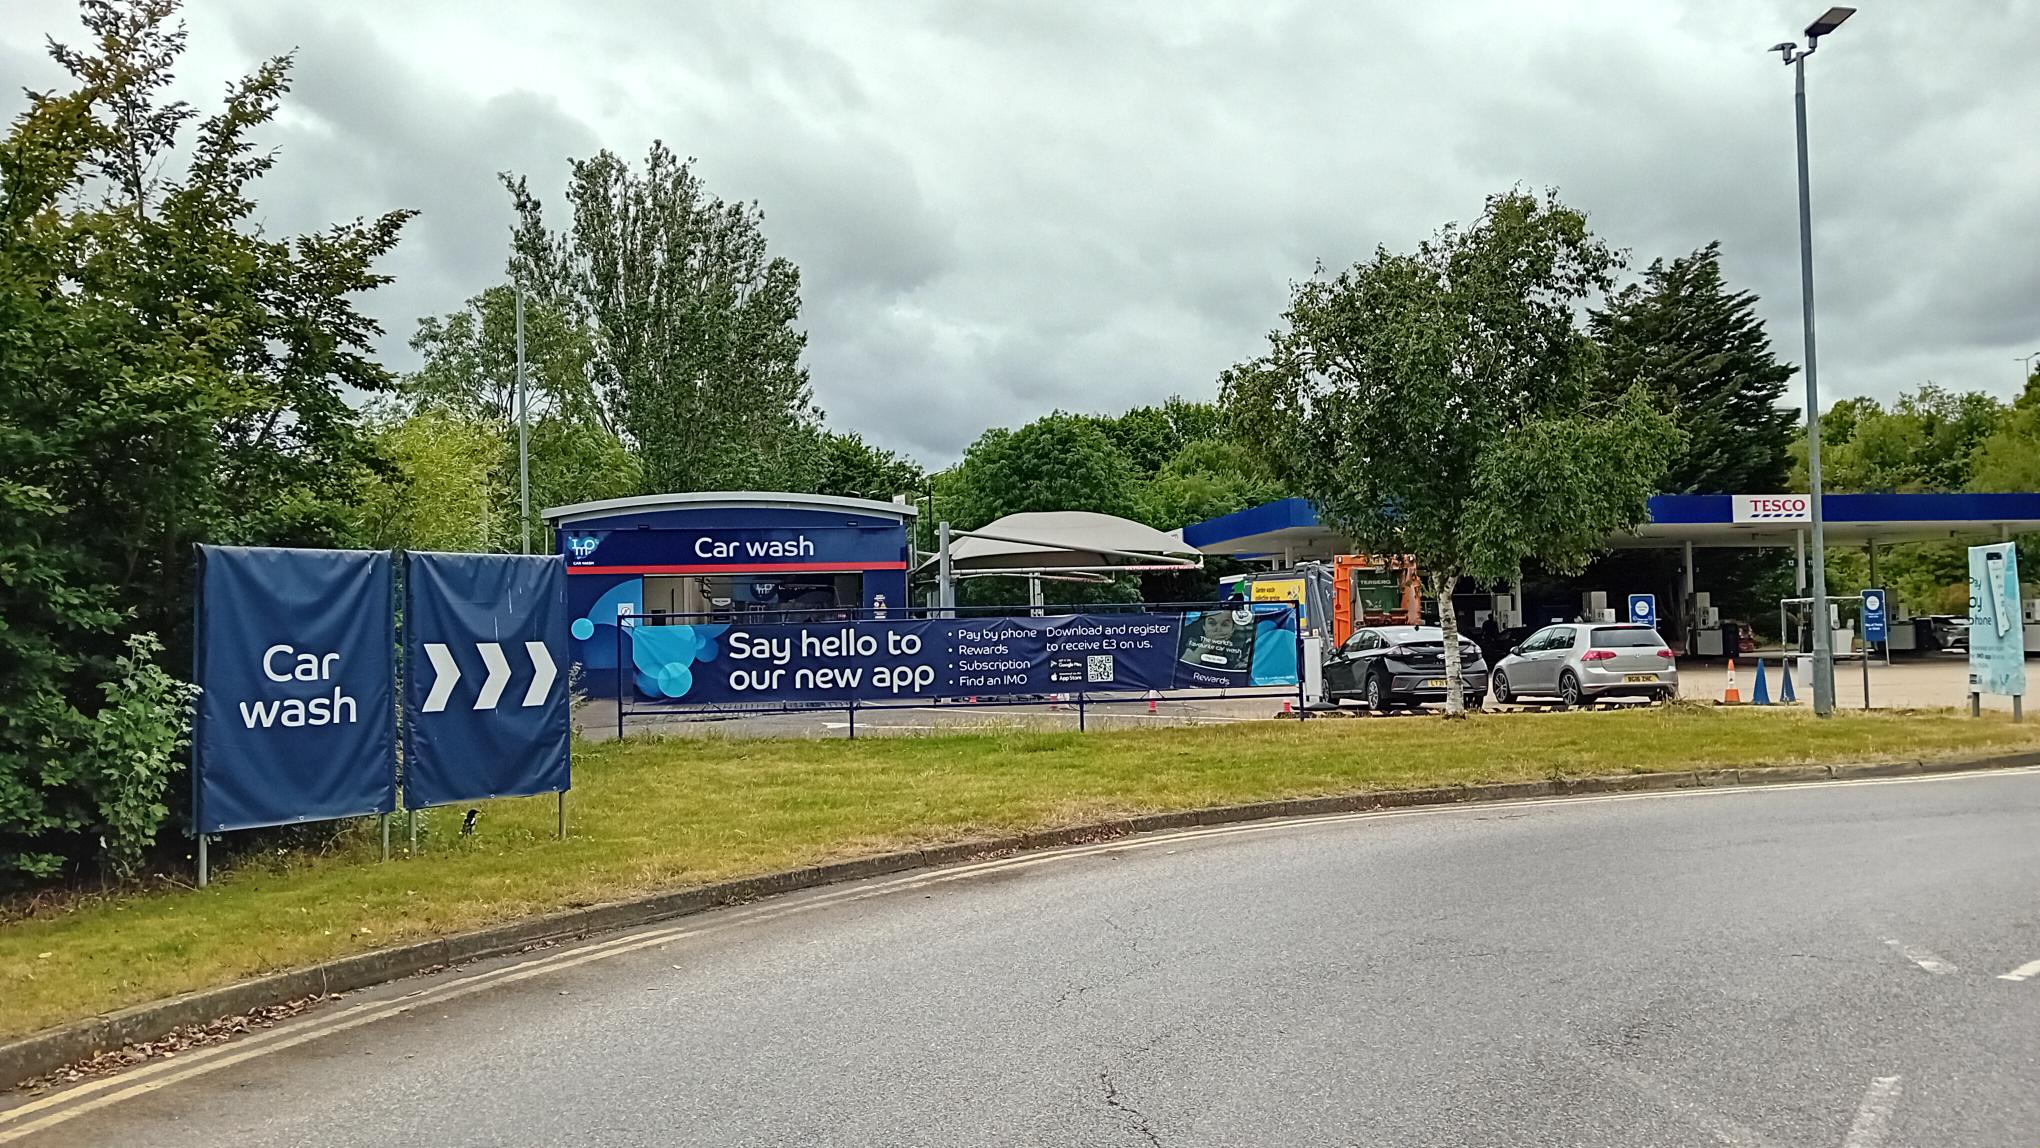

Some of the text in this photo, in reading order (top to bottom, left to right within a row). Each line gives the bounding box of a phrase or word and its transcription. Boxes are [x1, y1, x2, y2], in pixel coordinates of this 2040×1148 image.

[1749, 499, 1806, 512] TESCO
[694, 535, 815, 558] Car wash
[958, 627, 1038, 642] Pay by phone
[1046, 623, 1171, 637] Download and register
[1046, 639, 1153, 652] to receive £3 on us.
[1200, 635, 1211, 643] The
[729, 628, 922, 665] Say hello to
[958, 643, 1009, 655] Rewards
[263, 644, 340, 682] Car
[959, 658, 1031, 671] Subscription
[729, 665, 935, 693] our new app
[959, 674, 1028, 686] Find an IMO
[1193, 671, 1231, 686] Rewards
[239, 686, 357, 729] wash
